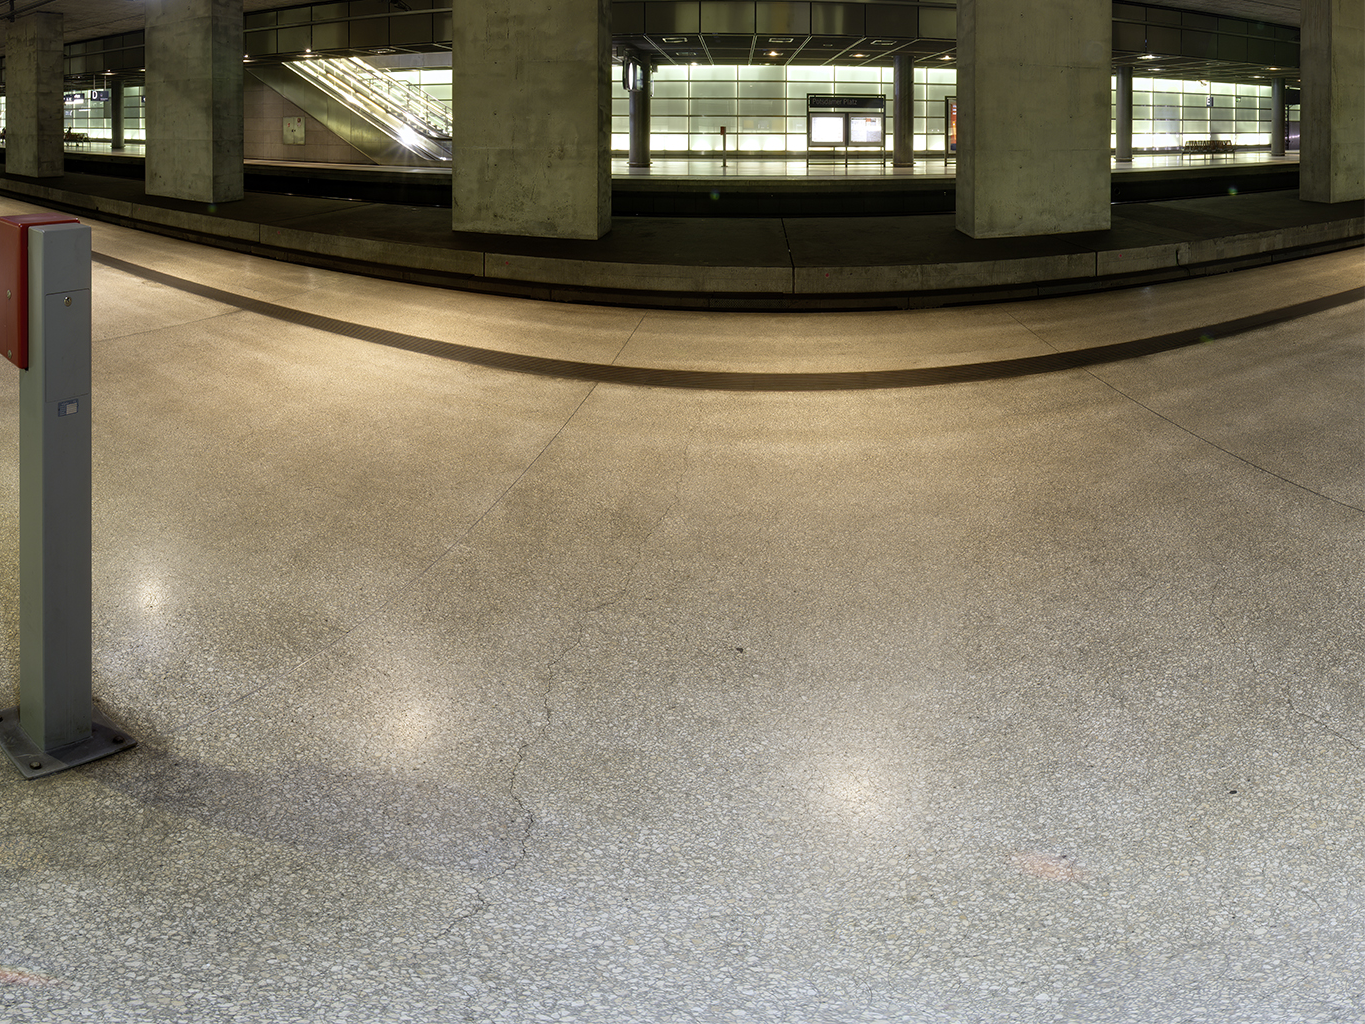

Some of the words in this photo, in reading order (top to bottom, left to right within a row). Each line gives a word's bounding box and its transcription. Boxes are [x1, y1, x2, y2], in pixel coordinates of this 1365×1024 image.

[92, 91, 98, 100] D
[812, 97, 842, 105] Potsdamer
[843, 98, 858, 106] Platz
